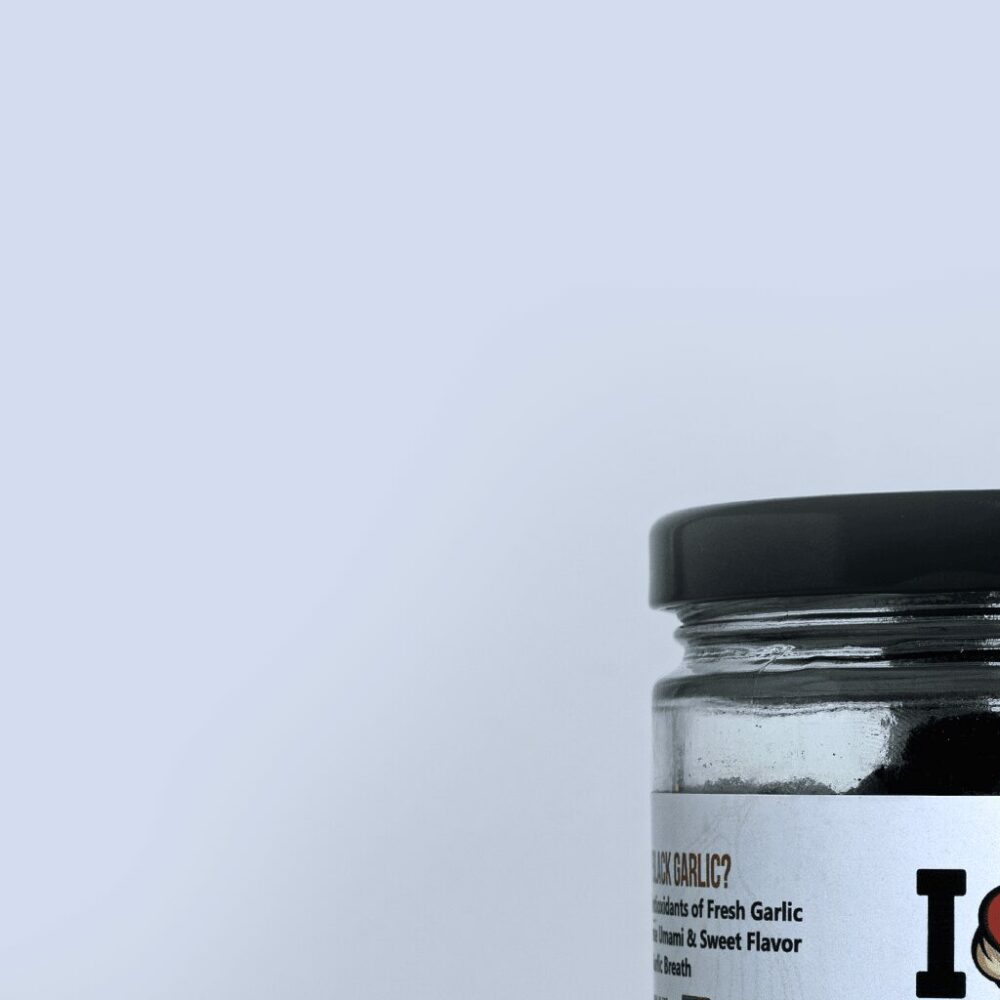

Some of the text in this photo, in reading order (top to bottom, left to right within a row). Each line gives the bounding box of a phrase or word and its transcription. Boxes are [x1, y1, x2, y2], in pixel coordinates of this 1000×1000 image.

[674, 853, 732, 889] GARLIC?
[691, 898, 704, 918] of
[707, 899, 745, 920] Fresh
[750, 900, 804, 922] Garlic
[659, 925, 684, 948] Umami
[687, 929, 697, 948] &
[700, 930, 742, 950] Sweet
[746, 932, 803, 953] Flavor
[915, 868, 967, 999] I
[664, 956, 692, 978] Breath
